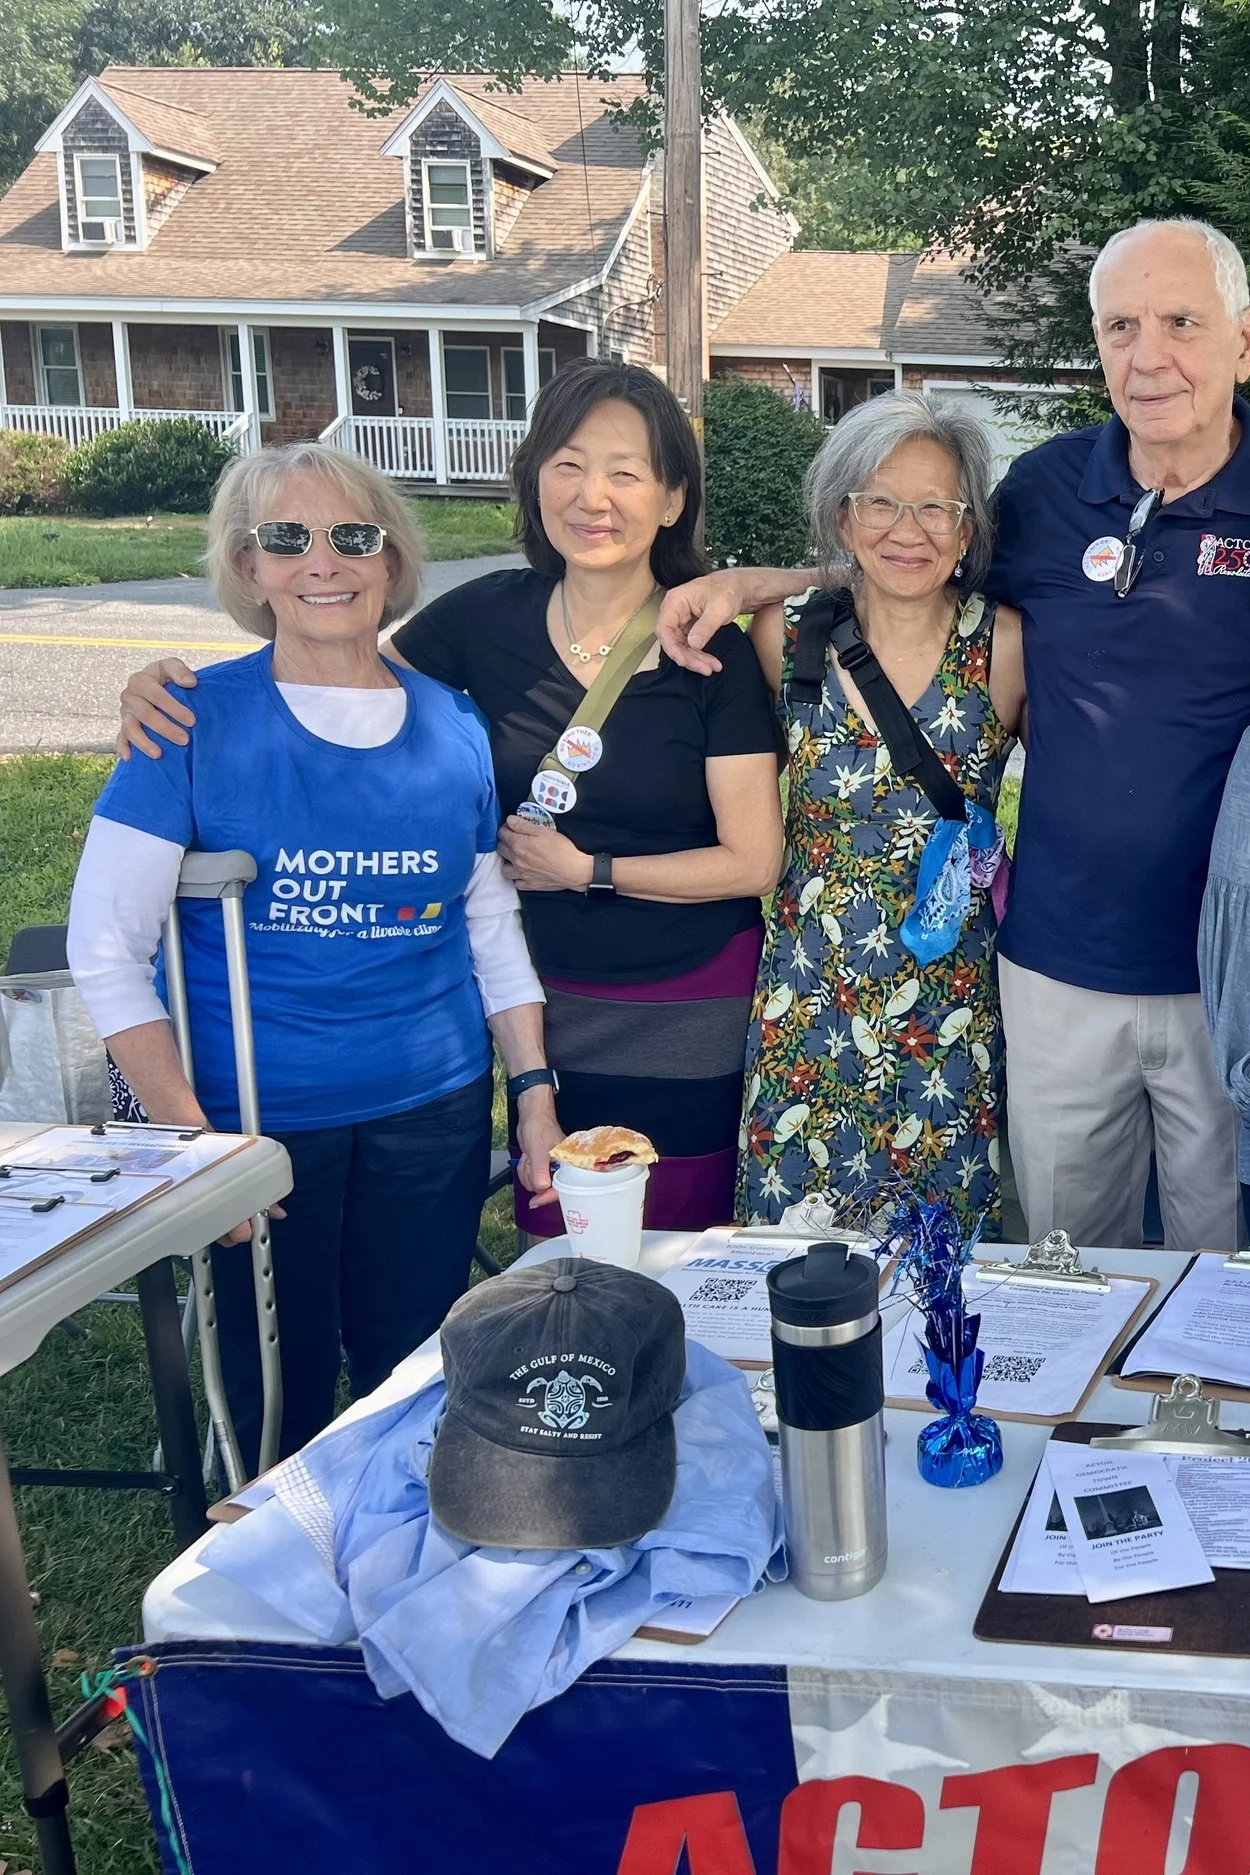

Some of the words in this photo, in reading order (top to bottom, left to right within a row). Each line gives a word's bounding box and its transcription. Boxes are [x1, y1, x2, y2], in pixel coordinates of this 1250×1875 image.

[274, 848, 439, 876] MOTHERS
[272, 878, 347, 902] OUT
[269, 902, 384, 926] FRONT
[248, 922, 330, 938] Mobilizing
[357, 930, 369, 939] a
[371, 925, 412, 939] livable
[509, 1364, 529, 1381] THE
[530, 1355, 557, 1369] GULF
[560, 1353, 575, 1362] OF
[578, 1353, 616, 1376] MEXICO
[520, 1426, 538, 1434] STAY
[539, 1429, 561, 1438] SALTY
[1086, 1460, 1114, 1468] ACTON
[1076, 1465, 1129, 1477] DEMOCRATIC
[1092, 1475, 1118, 1483] TOWN
[1083, 1481, 1133, 1493] COMMITTEE
[1115, 1537, 1133, 1545] THE
[1135, 1530, 1164, 1541] PARTY
[1131, 1543, 1152, 1551] People
[824, 1548, 866, 1563] contigo
[1134, 1551, 1154, 1559] People
[1138, 1558, 1159, 1566] People
